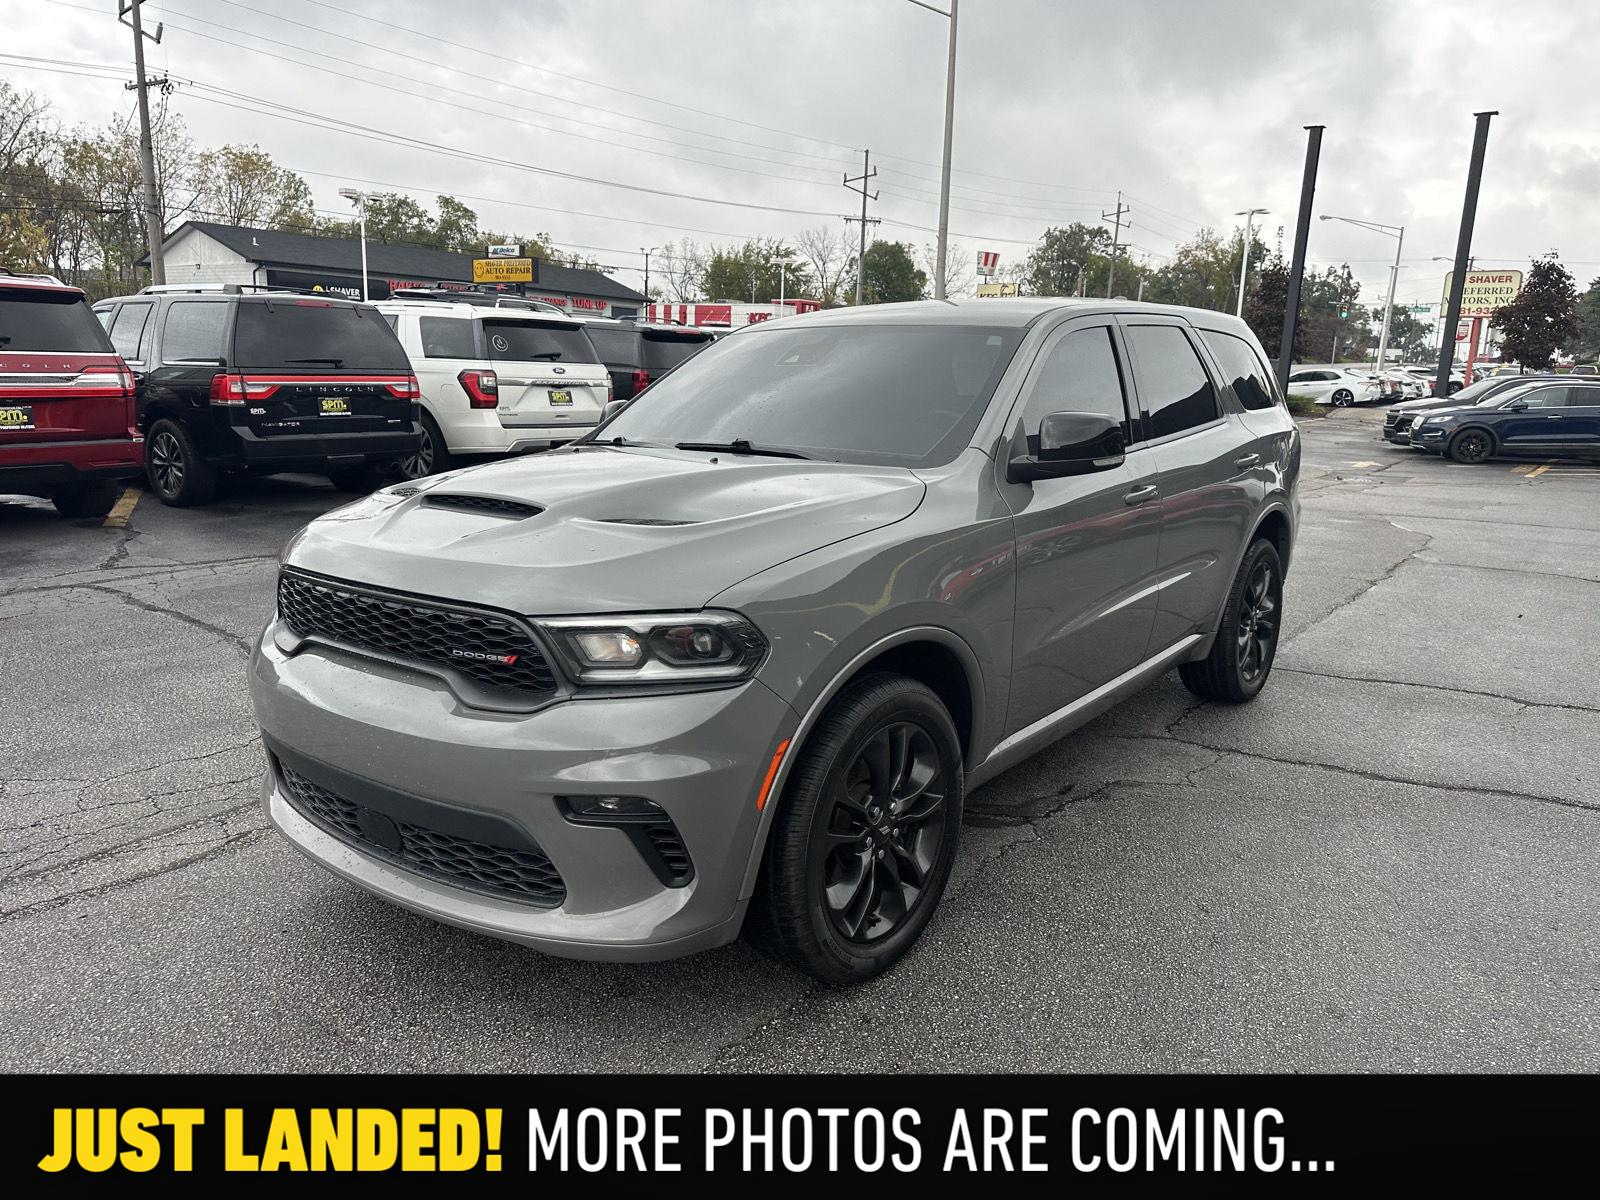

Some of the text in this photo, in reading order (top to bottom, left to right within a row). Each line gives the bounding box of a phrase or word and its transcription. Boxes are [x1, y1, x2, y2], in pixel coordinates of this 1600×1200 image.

[485, 267, 531, 275] AUTO REPAIR
[1469, 275, 1513, 284] SHAVER
[1463, 286, 1513, 295] EFERRED
[453, 650, 508, 662] DODGE
